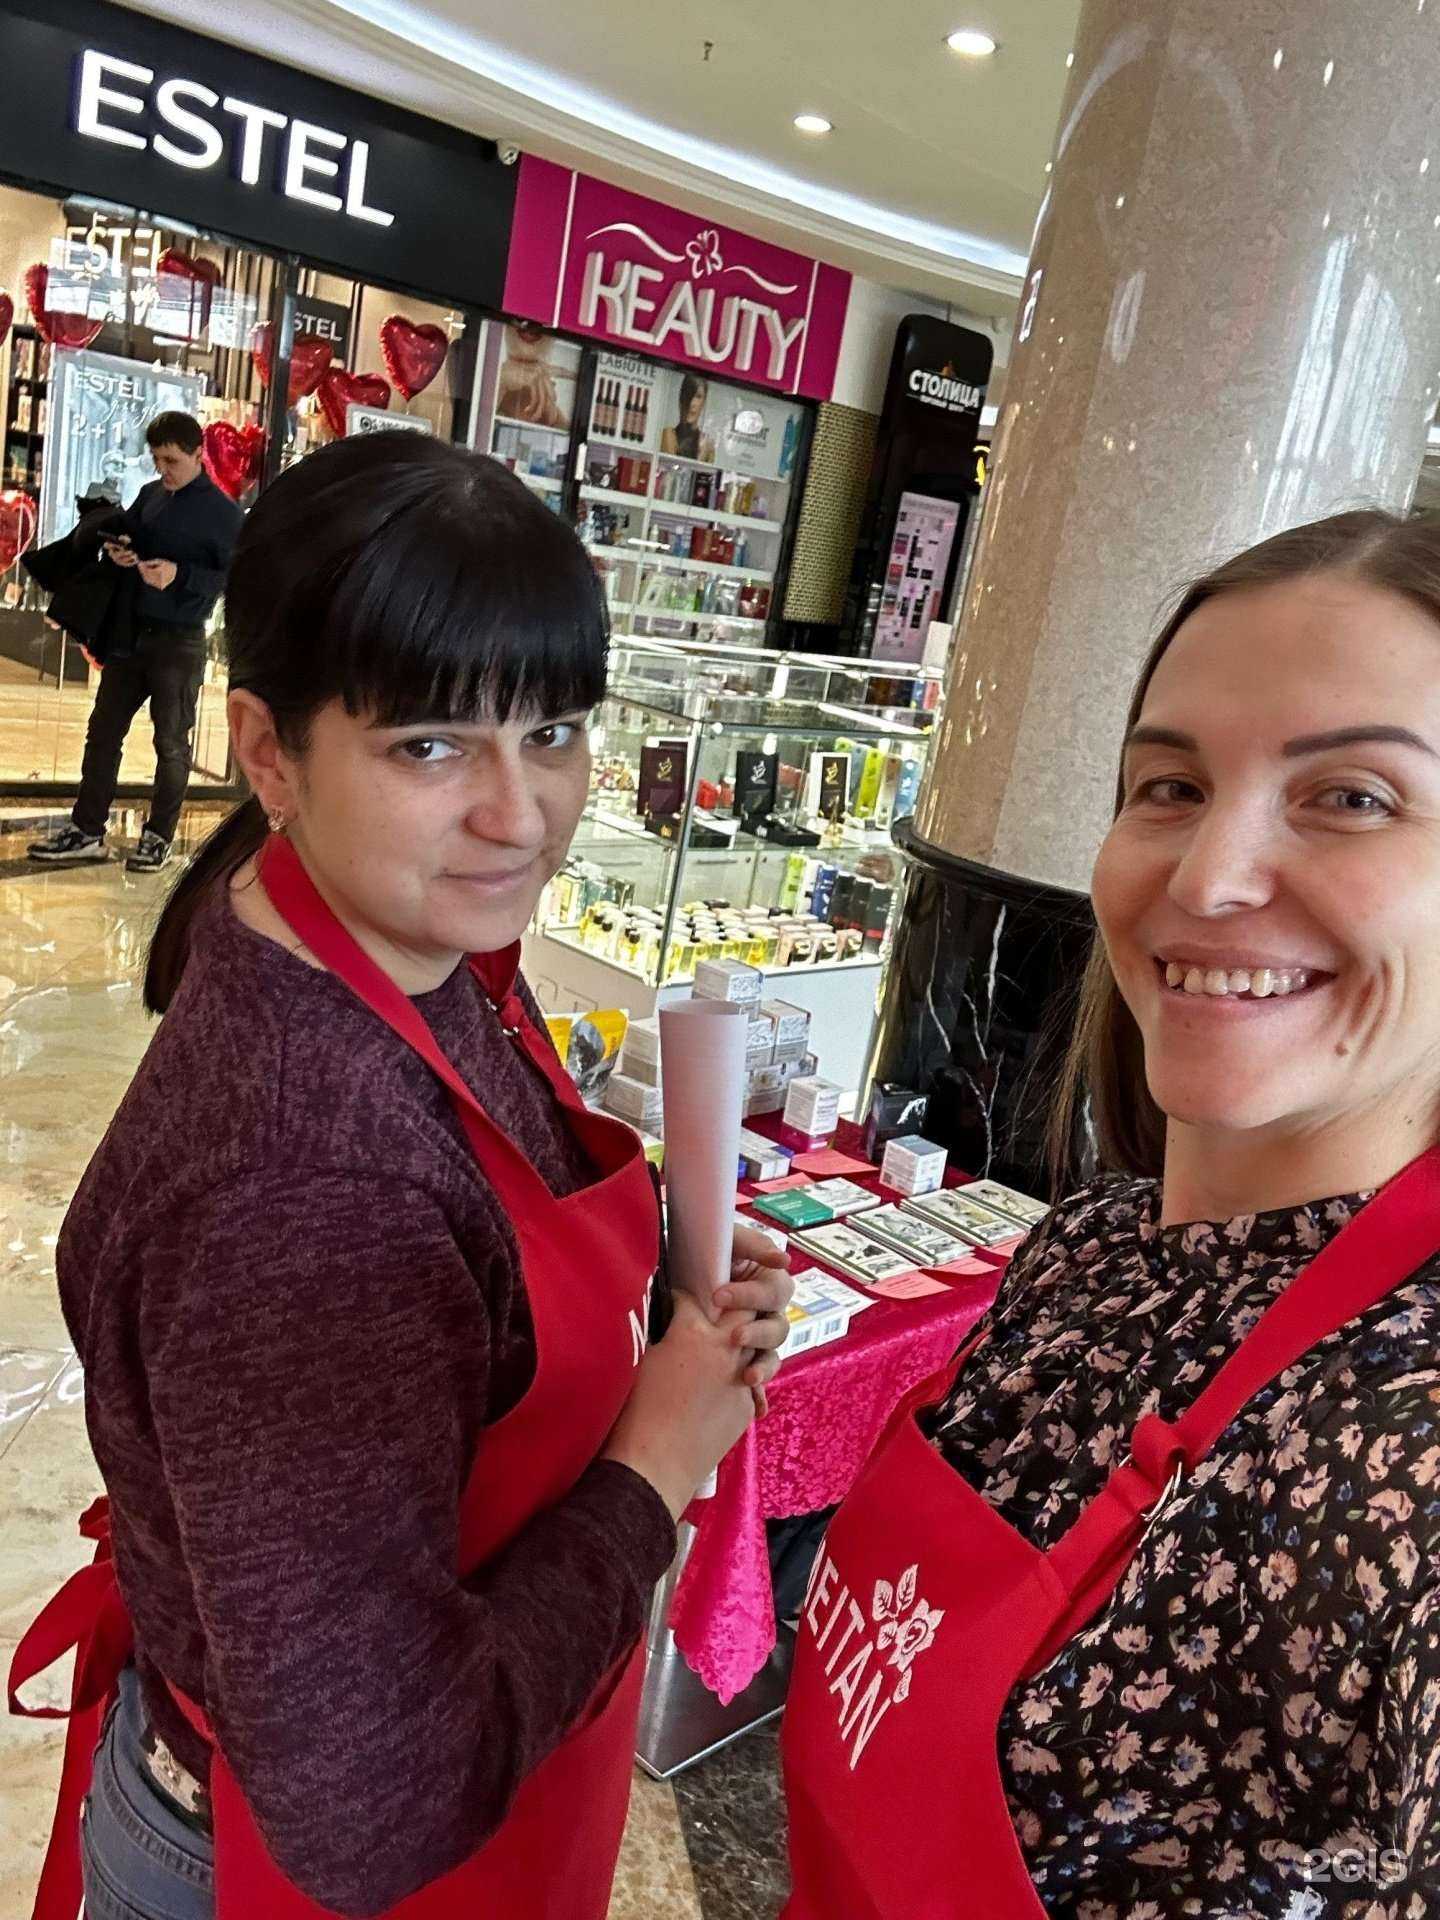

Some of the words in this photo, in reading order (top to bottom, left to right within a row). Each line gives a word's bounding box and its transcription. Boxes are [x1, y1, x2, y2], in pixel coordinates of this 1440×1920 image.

[77, 48, 396, 228] ESTEL
[294, 311, 343, 342] STEL
[579, 251, 806, 381] KEAUTY
[75, 370, 145, 401] ESTEL
[909, 369, 980, 409] СТОЛИЦА
